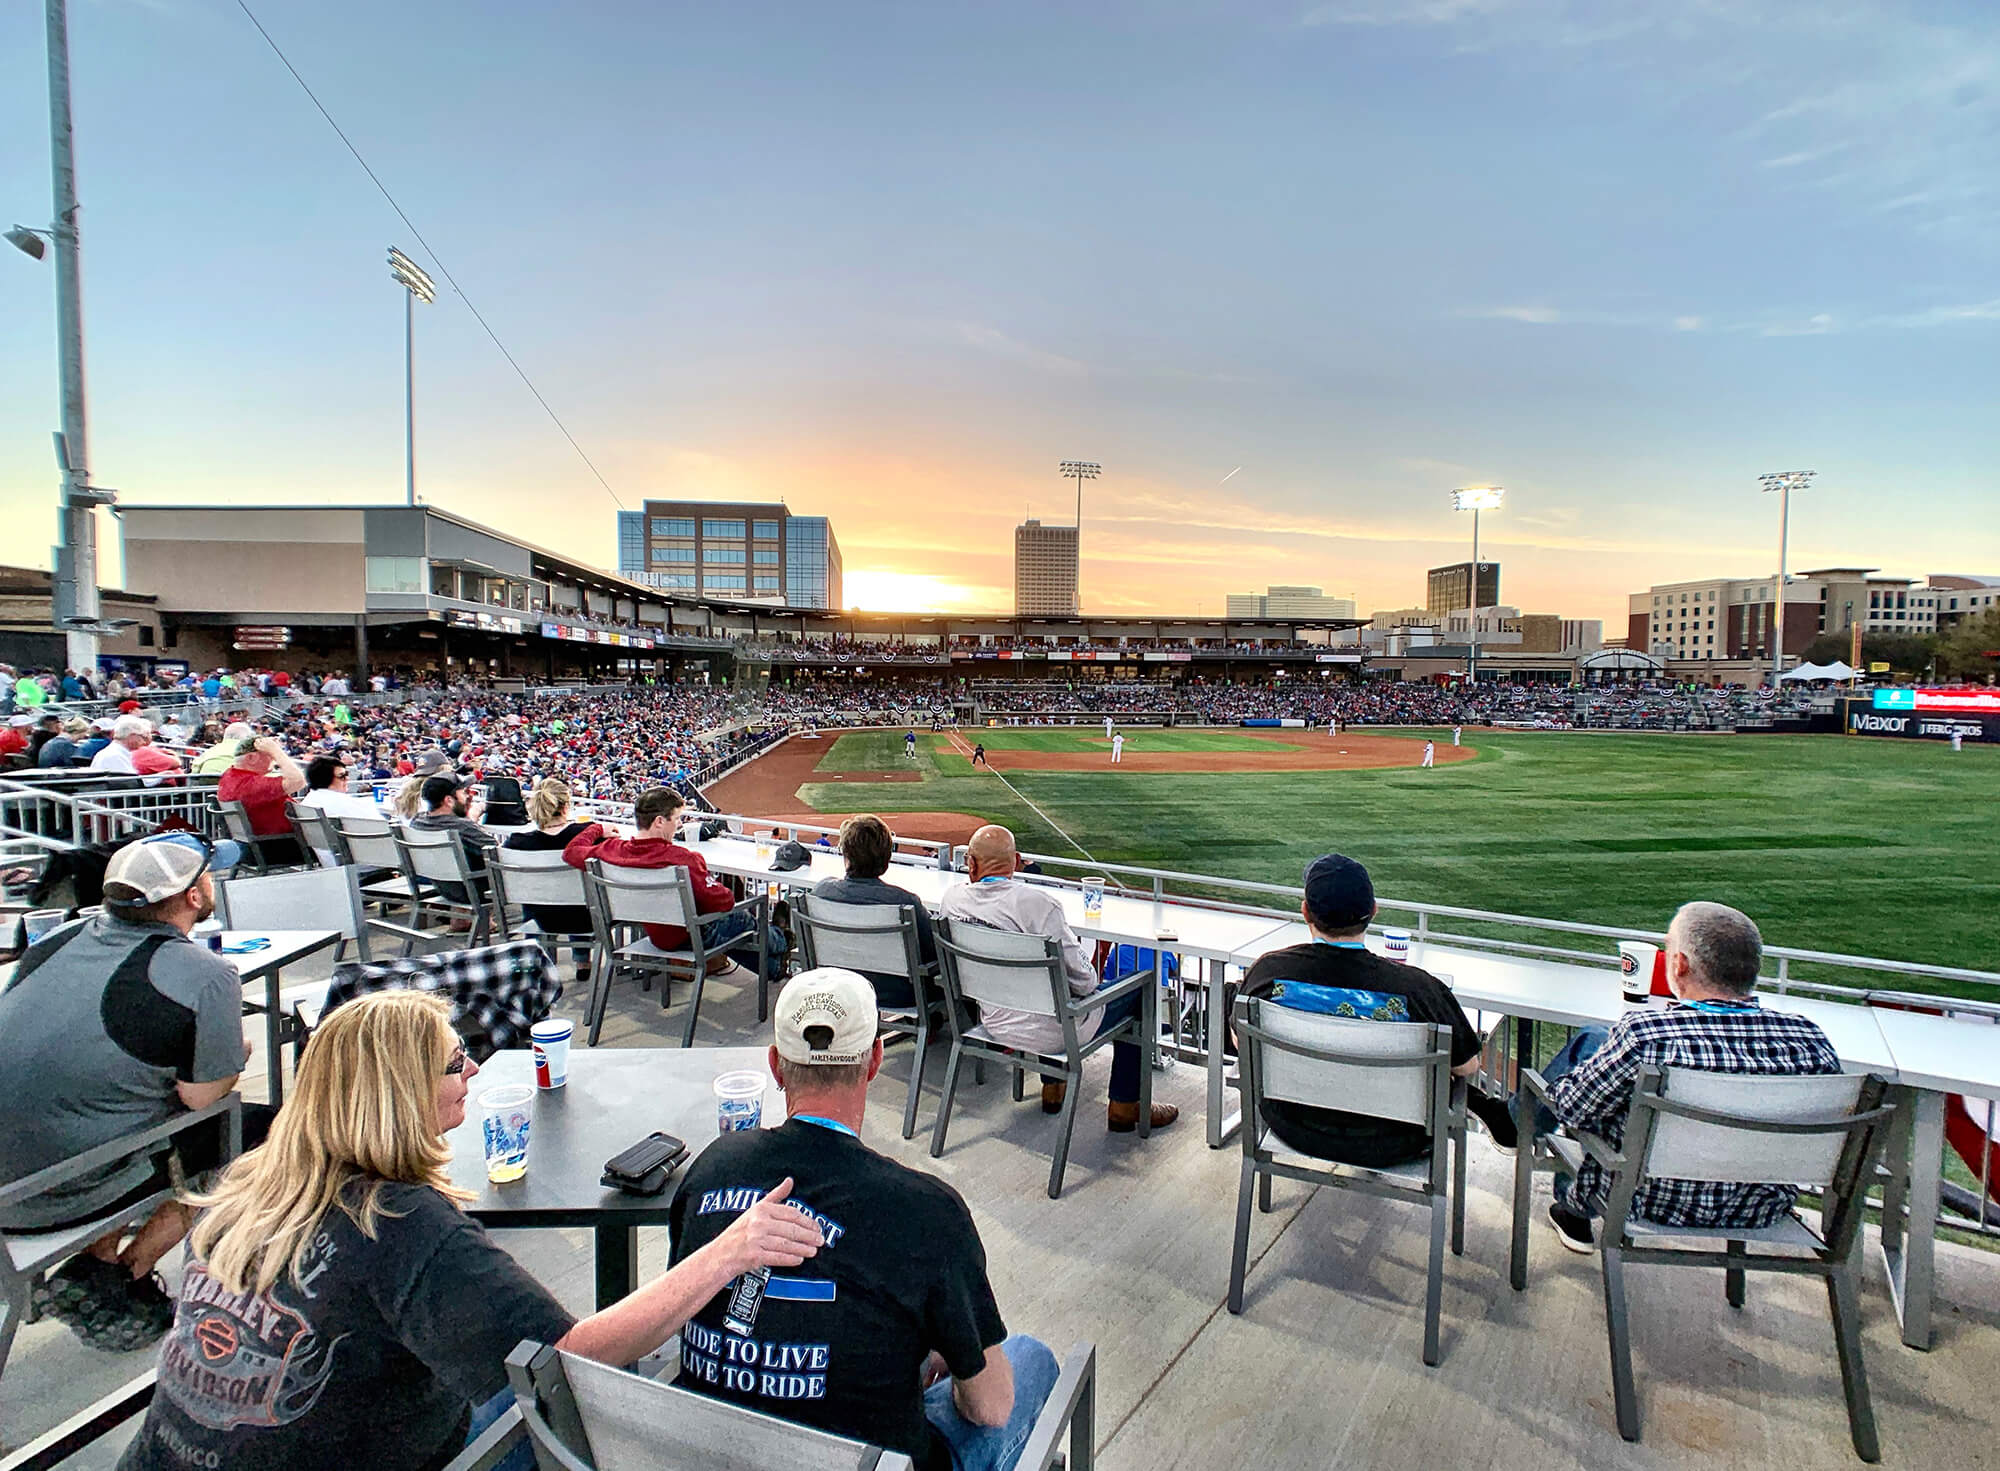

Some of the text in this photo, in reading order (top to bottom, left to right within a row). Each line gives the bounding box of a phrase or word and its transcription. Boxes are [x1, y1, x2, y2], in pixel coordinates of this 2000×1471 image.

[1853, 713, 1909, 732] Maxor
[1920, 723, 1926, 735] J
[1927, 723, 1952, 735] FERG
[684, 1321, 828, 1369] RIDE TO LIVE
[682, 1345, 825, 1399] LIVE TO RIDE
